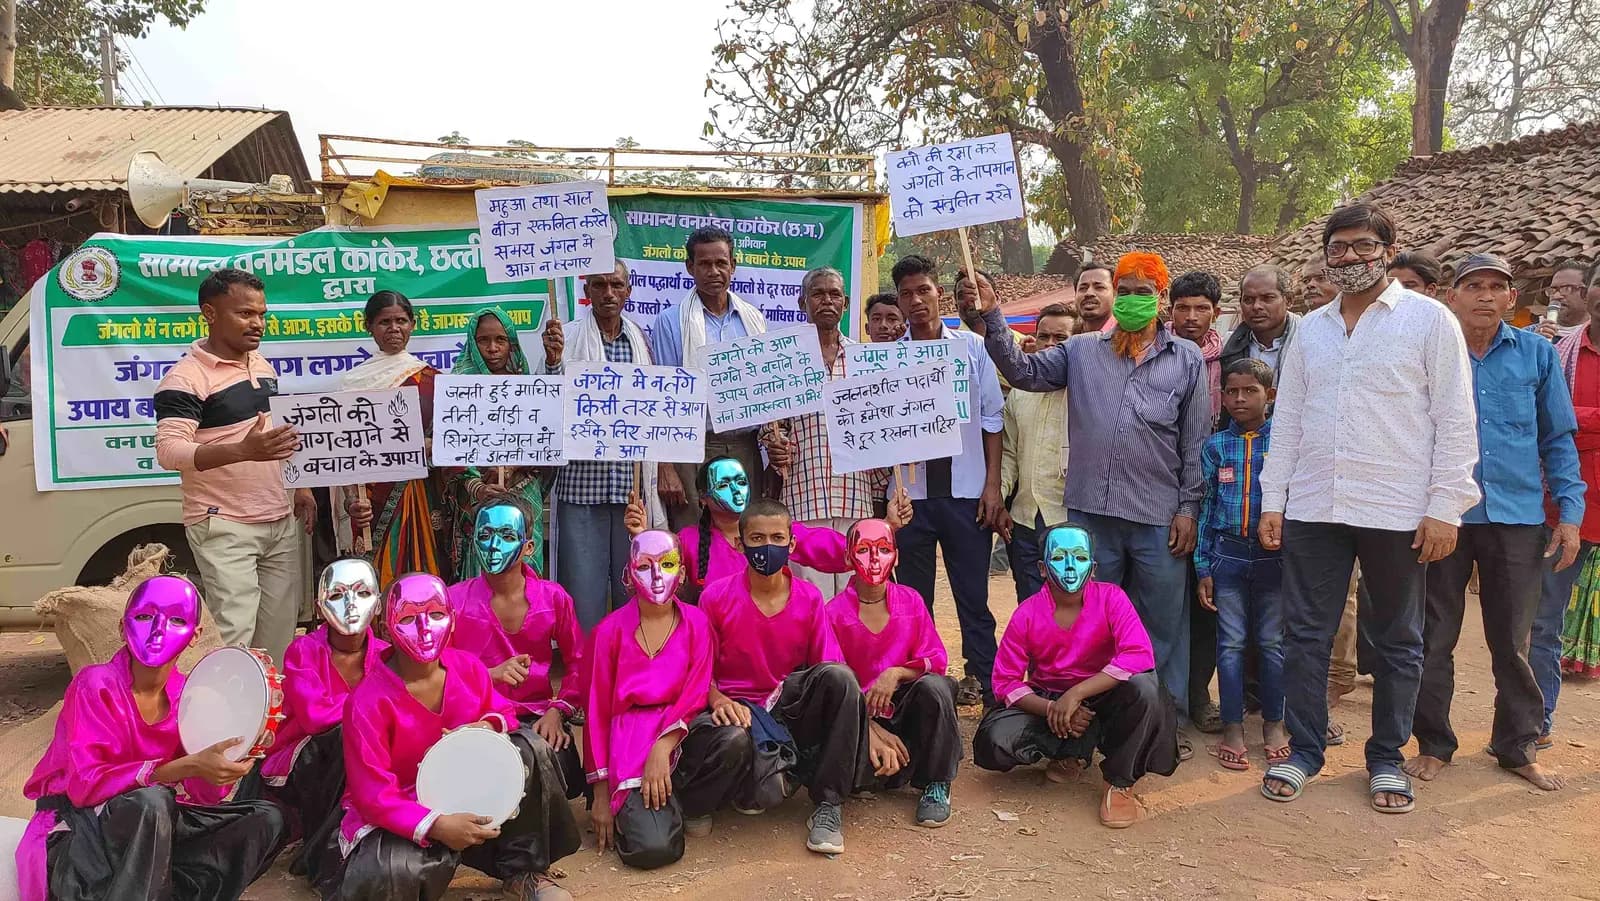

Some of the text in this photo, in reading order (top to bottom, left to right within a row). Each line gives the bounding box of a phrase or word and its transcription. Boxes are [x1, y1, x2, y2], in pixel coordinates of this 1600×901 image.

[924, 146, 943, 163] की
[975, 141, 999, 156] कर
[949, 165, 968, 183] के
[966, 160, 1016, 181] तापमान
[489, 190, 594, 218] महुआ तथा साल
[903, 196, 924, 220] को
[491, 221, 522, 238] बीज
[579, 207, 609, 229] करते
[625, 210, 679, 229] सामान्य
[736, 214, 781, 238] कांकेर
[781, 220, 825, 241] (छ.ग.)
[137, 252, 233, 278] सामान्य
[233, 240, 337, 276] वनमंडल
[339, 237, 425, 277] कांकेर,
[494, 242, 535, 260] समय
[540, 236, 578, 256] जंगल
[642, 244, 672, 260] जंगलो
[745, 249, 770, 266] बचाने
[770, 251, 782, 267] के
[505, 261, 536, 278] आग
[539, 260, 551, 273] न
[321, 277, 376, 300] द्वारा
[756, 279, 765, 295] से
[766, 283, 779, 300] दूर
[780, 284, 803, 297] रखन
[266, 316, 282, 337] से
[316, 312, 353, 336] इसके
[420, 309, 430, 330] है
[431, 311, 470, 331] जागरू
[765, 304, 796, 323] माचिस
[97, 317, 142, 340] जंगलो
[144, 316, 158, 339] में
[159, 322, 171, 339] न
[172, 316, 198, 338] लगे
[707, 334, 799, 367] जंगलो को आग
[853, 345, 890, 364] जंगल
[913, 343, 951, 360] आग
[573, 366, 698, 395] जंगलो मे न लगे
[708, 351, 812, 388] लगने से बचाने के
[446, 377, 564, 404] जलती हुई माचिस
[714, 386, 749, 404] उपाय
[753, 375, 787, 397] बताने
[787, 373, 804, 388] के
[831, 377, 902, 405] ज्वलनशील
[68, 398, 132, 422] उपाय
[282, 396, 384, 427] जंगलो को
[487, 404, 524, 427] बीड़ी
[528, 408, 542, 424] व
[573, 393, 710, 419] किसी तरह से आग
[836, 397, 937, 427] को हमेशा जंगल
[333, 421, 385, 449] लगने
[390, 418, 412, 443] से
[441, 427, 492, 449] सिगरेट
[490, 427, 534, 448] जंगल
[570, 418, 607, 441] इसके
[608, 418, 642, 441] लिए
[842, 430, 855, 450] से
[858, 431, 876, 451] दूर
[880, 424, 917, 443] रखना
[104, 435, 137, 450] वन
[593, 440, 649, 460] हो आप
[303, 455, 357, 475] बचाव
[358, 449, 380, 468] के
[486, 447, 524, 463] डालनी
